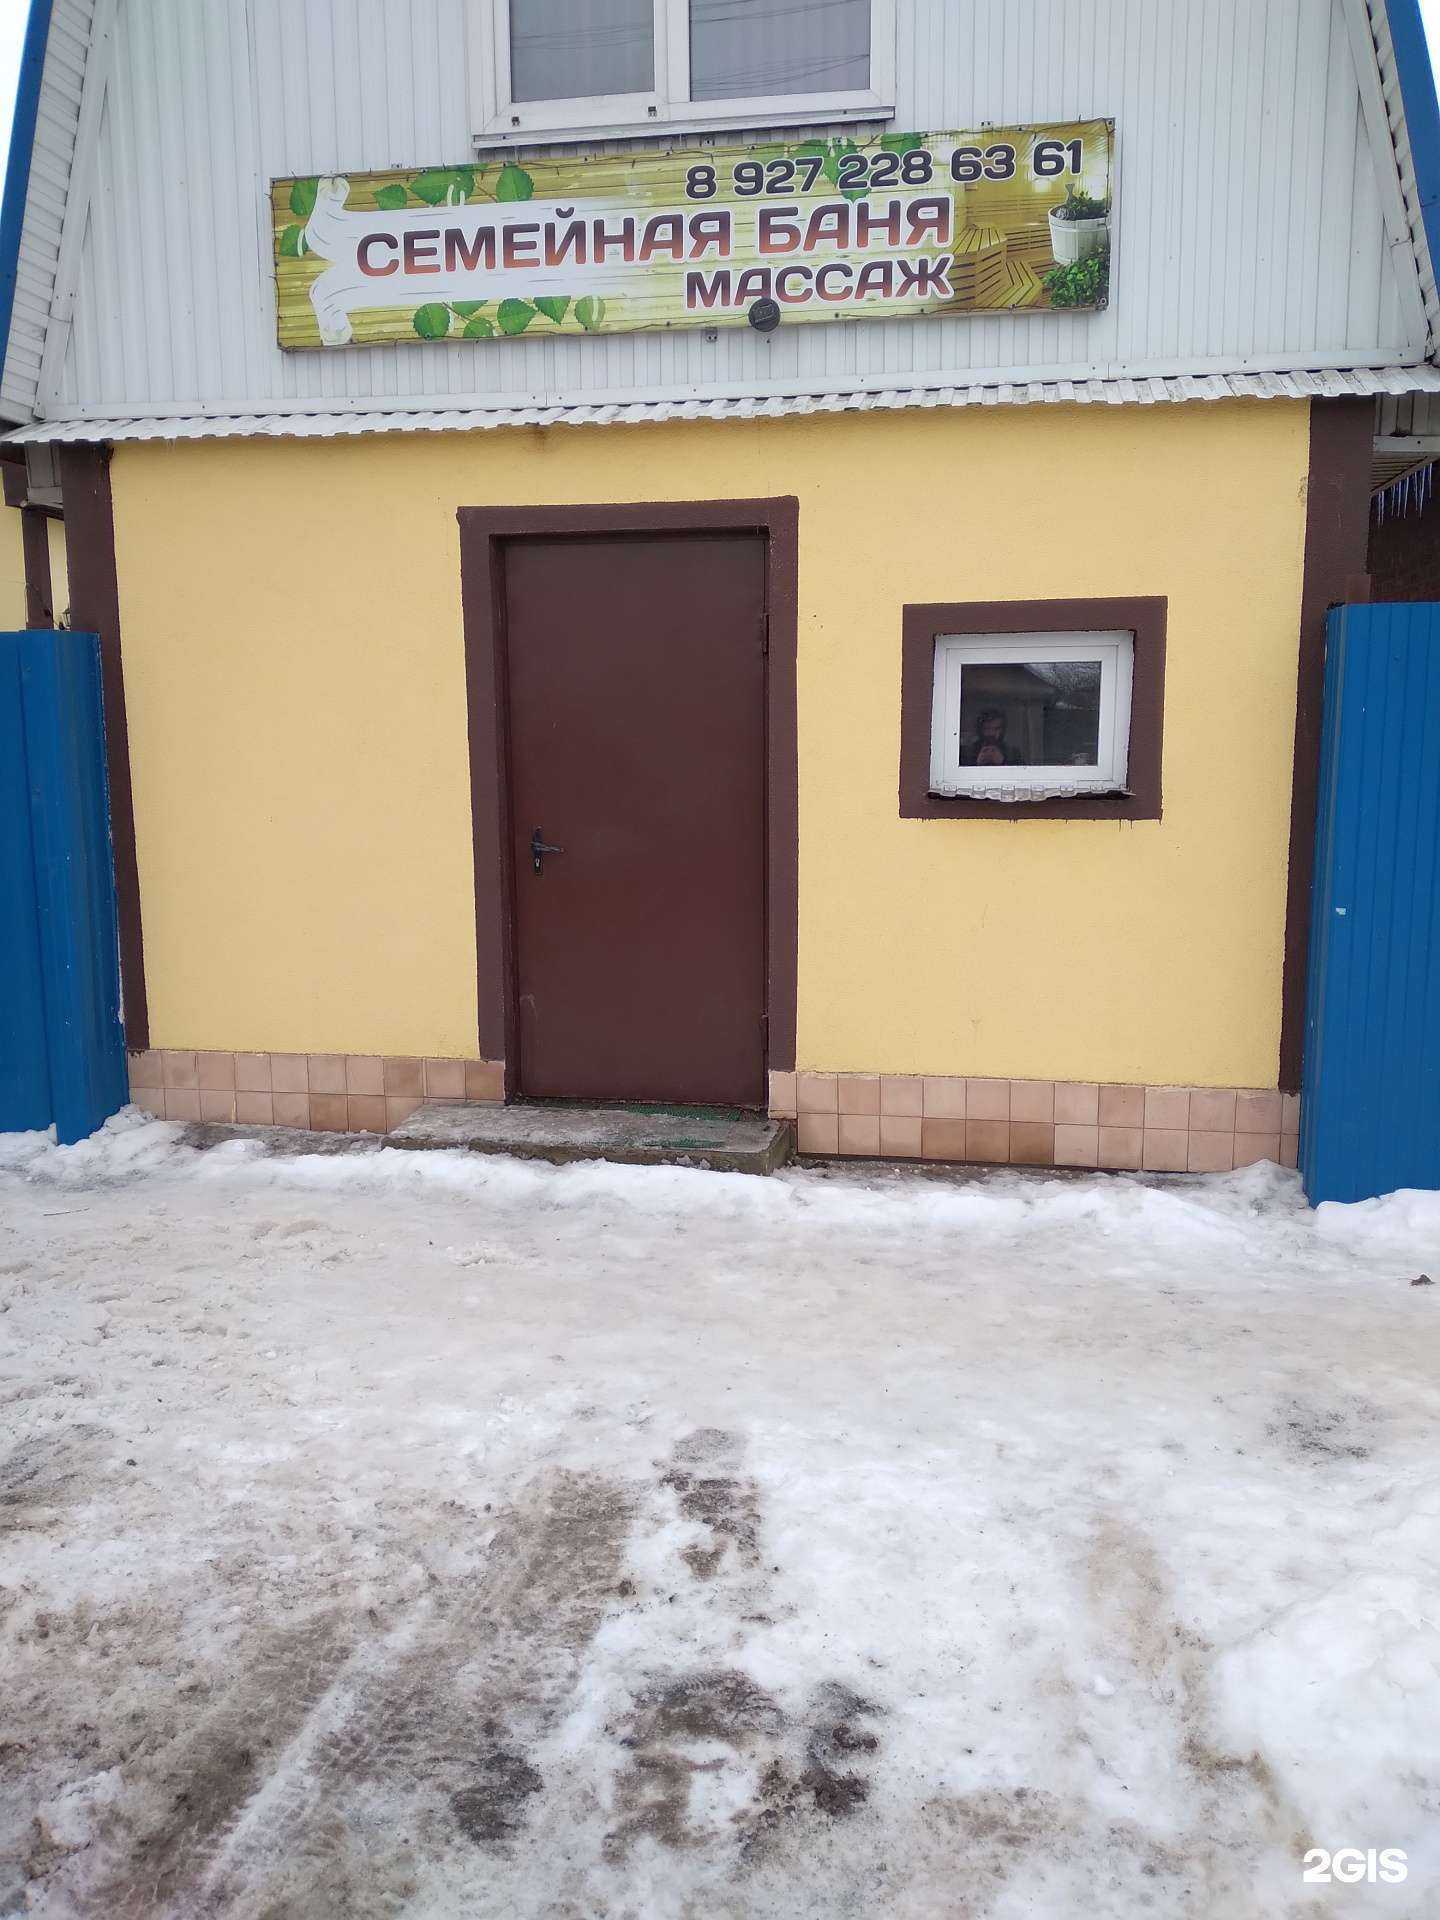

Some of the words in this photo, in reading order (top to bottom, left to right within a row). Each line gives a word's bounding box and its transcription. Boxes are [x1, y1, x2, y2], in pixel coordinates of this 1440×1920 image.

[686, 165, 717, 199] 8
[733, 157, 823, 196] 927
[838, 150, 933, 189] 228
[951, 145, 1015, 182] 63
[1033, 139, 1082, 176] 61
[356, 206, 731, 277] СЕМЕЙНАЯ
[758, 196, 950, 254] БАНЯ
[686, 256, 952, 309] МАССАЖ
